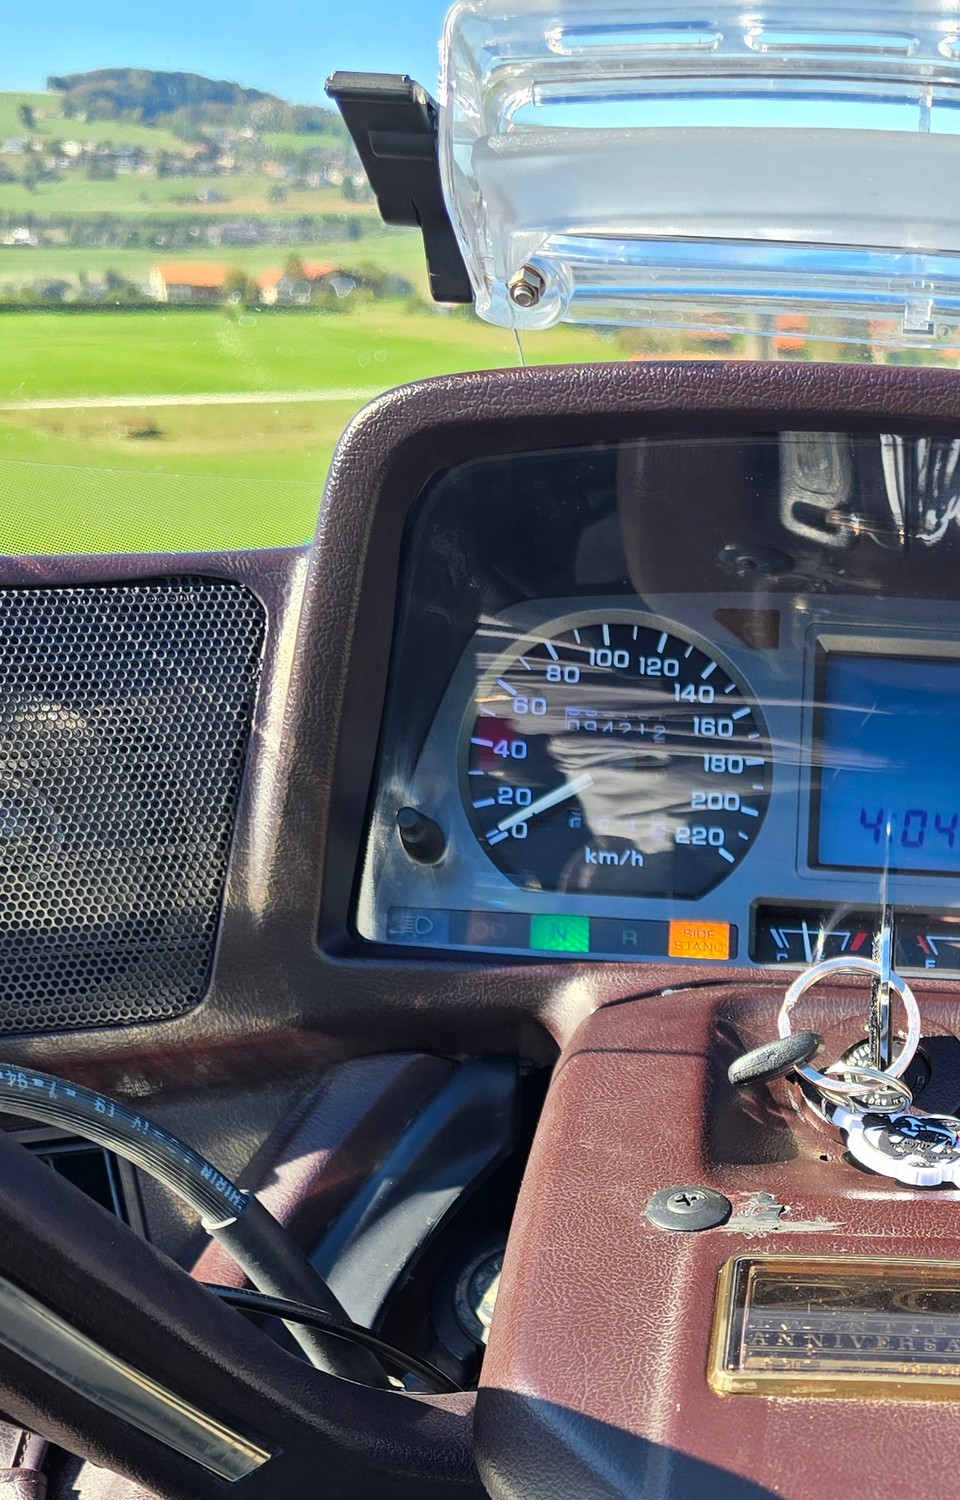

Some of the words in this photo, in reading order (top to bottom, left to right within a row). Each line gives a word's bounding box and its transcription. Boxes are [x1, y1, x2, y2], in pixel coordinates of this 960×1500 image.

[589, 648, 629, 669] 100
[639, 656, 680, 677] 120
[546, 665, 580, 685] 80
[674, 683, 715, 703] 140
[513, 697, 547, 716] 60
[693, 717, 734, 738] 160
[493, 740, 528, 760] 40
[703, 755, 745, 774] 180
[497, 787, 532, 806] 20
[691, 792, 740, 812] 200
[511, 821, 529, 839] 0
[675, 827, 725, 847] 220
[860, 808, 959, 849] 4:04
[585, 847, 644, 867] km/h
[552, 926, 568, 941] N
[622, 930, 638, 946] R
[683, 928, 715, 940] SIDE
[674, 940, 724, 953] STAND
